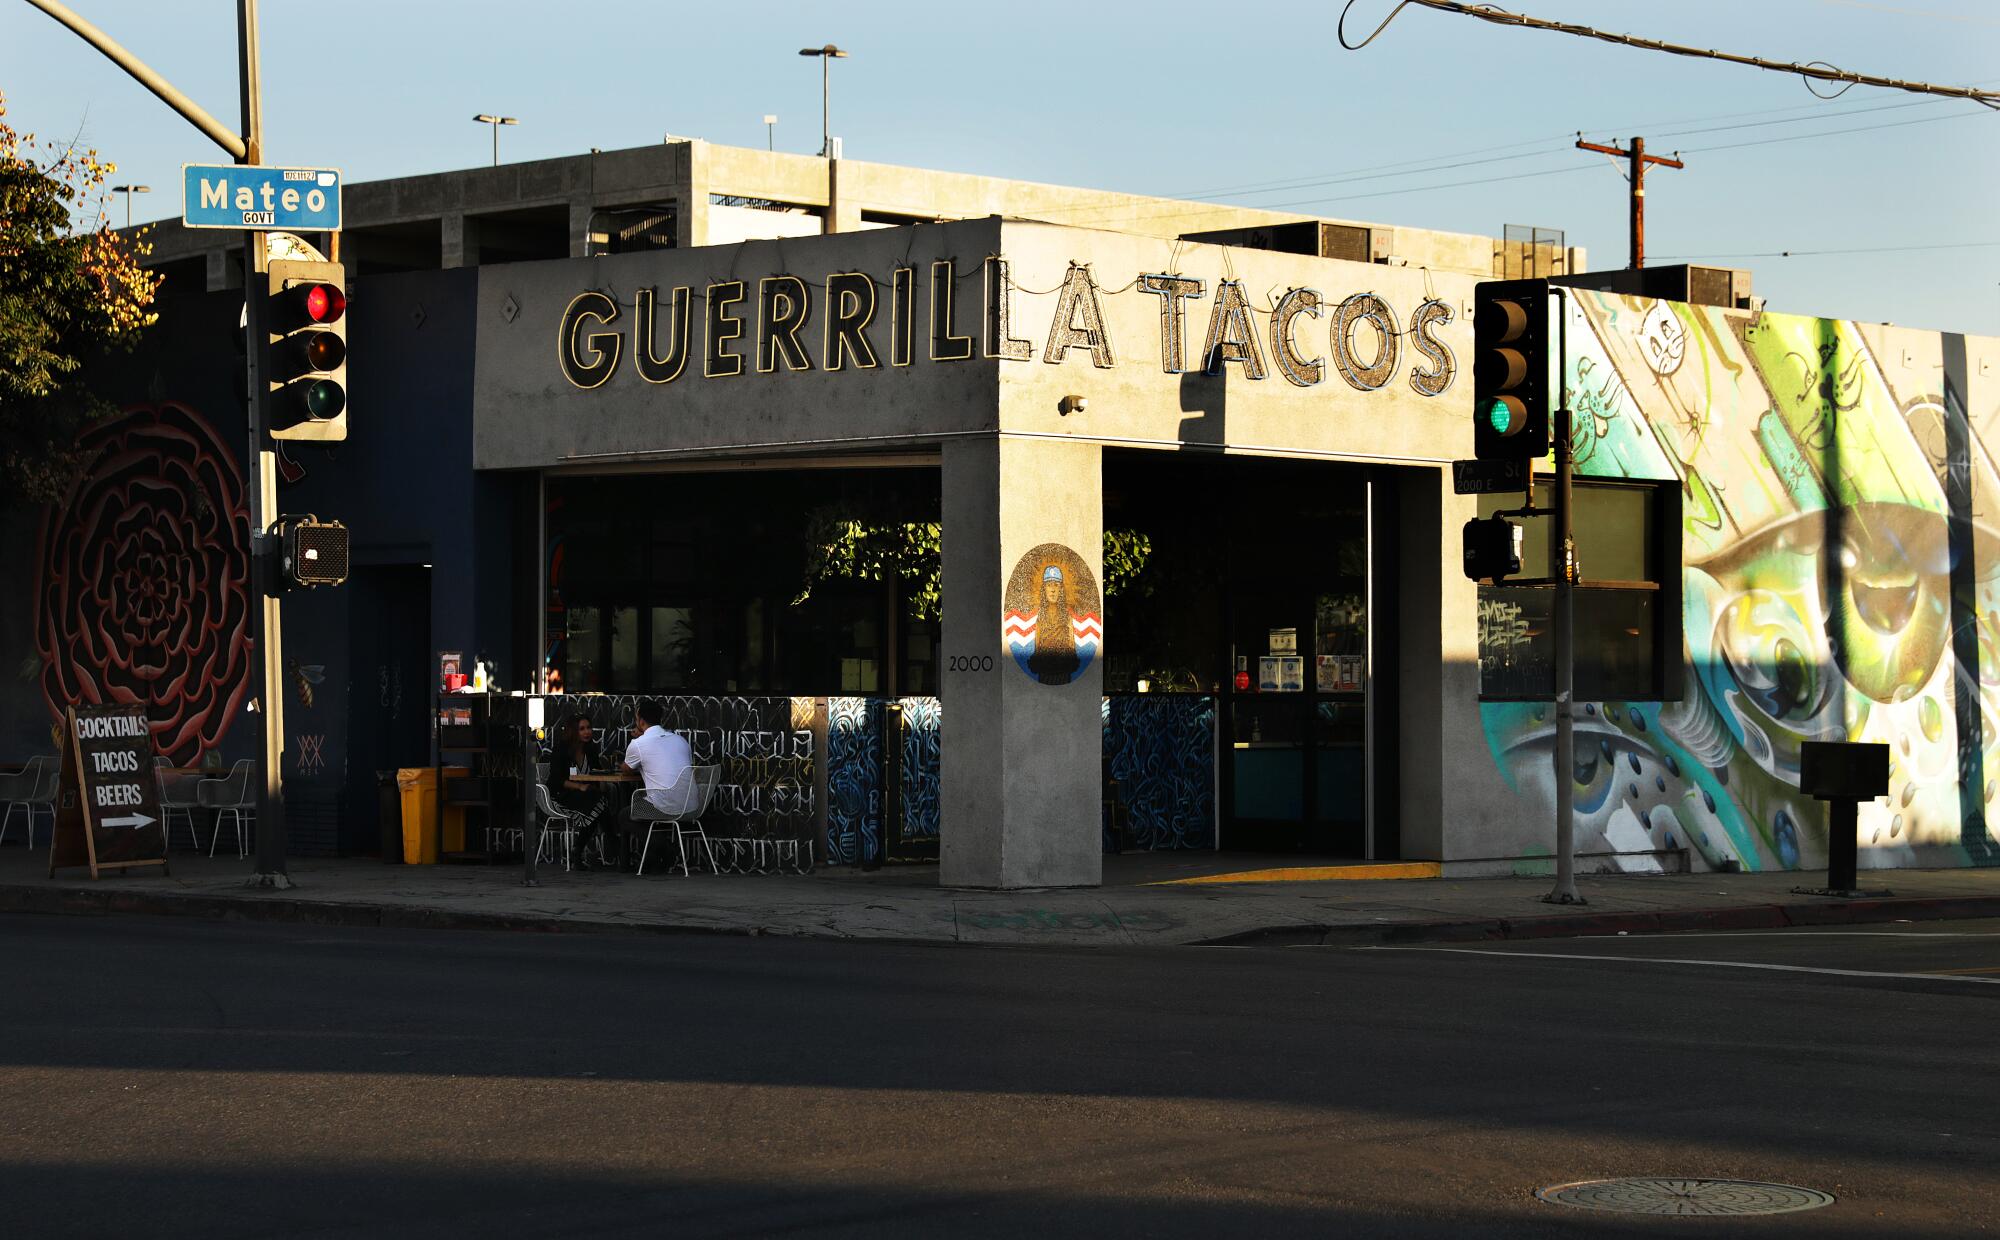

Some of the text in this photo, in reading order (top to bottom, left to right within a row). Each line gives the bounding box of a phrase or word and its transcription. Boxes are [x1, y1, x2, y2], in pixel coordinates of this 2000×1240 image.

[200, 178, 326, 213] Mateo
[243, 212, 273, 224] GOVT
[557, 255, 1459, 397] GUERRILLA TACOS
[1504, 462, 1521, 478] St
[1457, 479, 1482, 491] 2000
[949, 655, 993, 672] 2000
[76, 715, 149, 740] COCKTAILS
[91, 750, 139, 773] TACOS
[95, 783, 143, 807] BEERS
